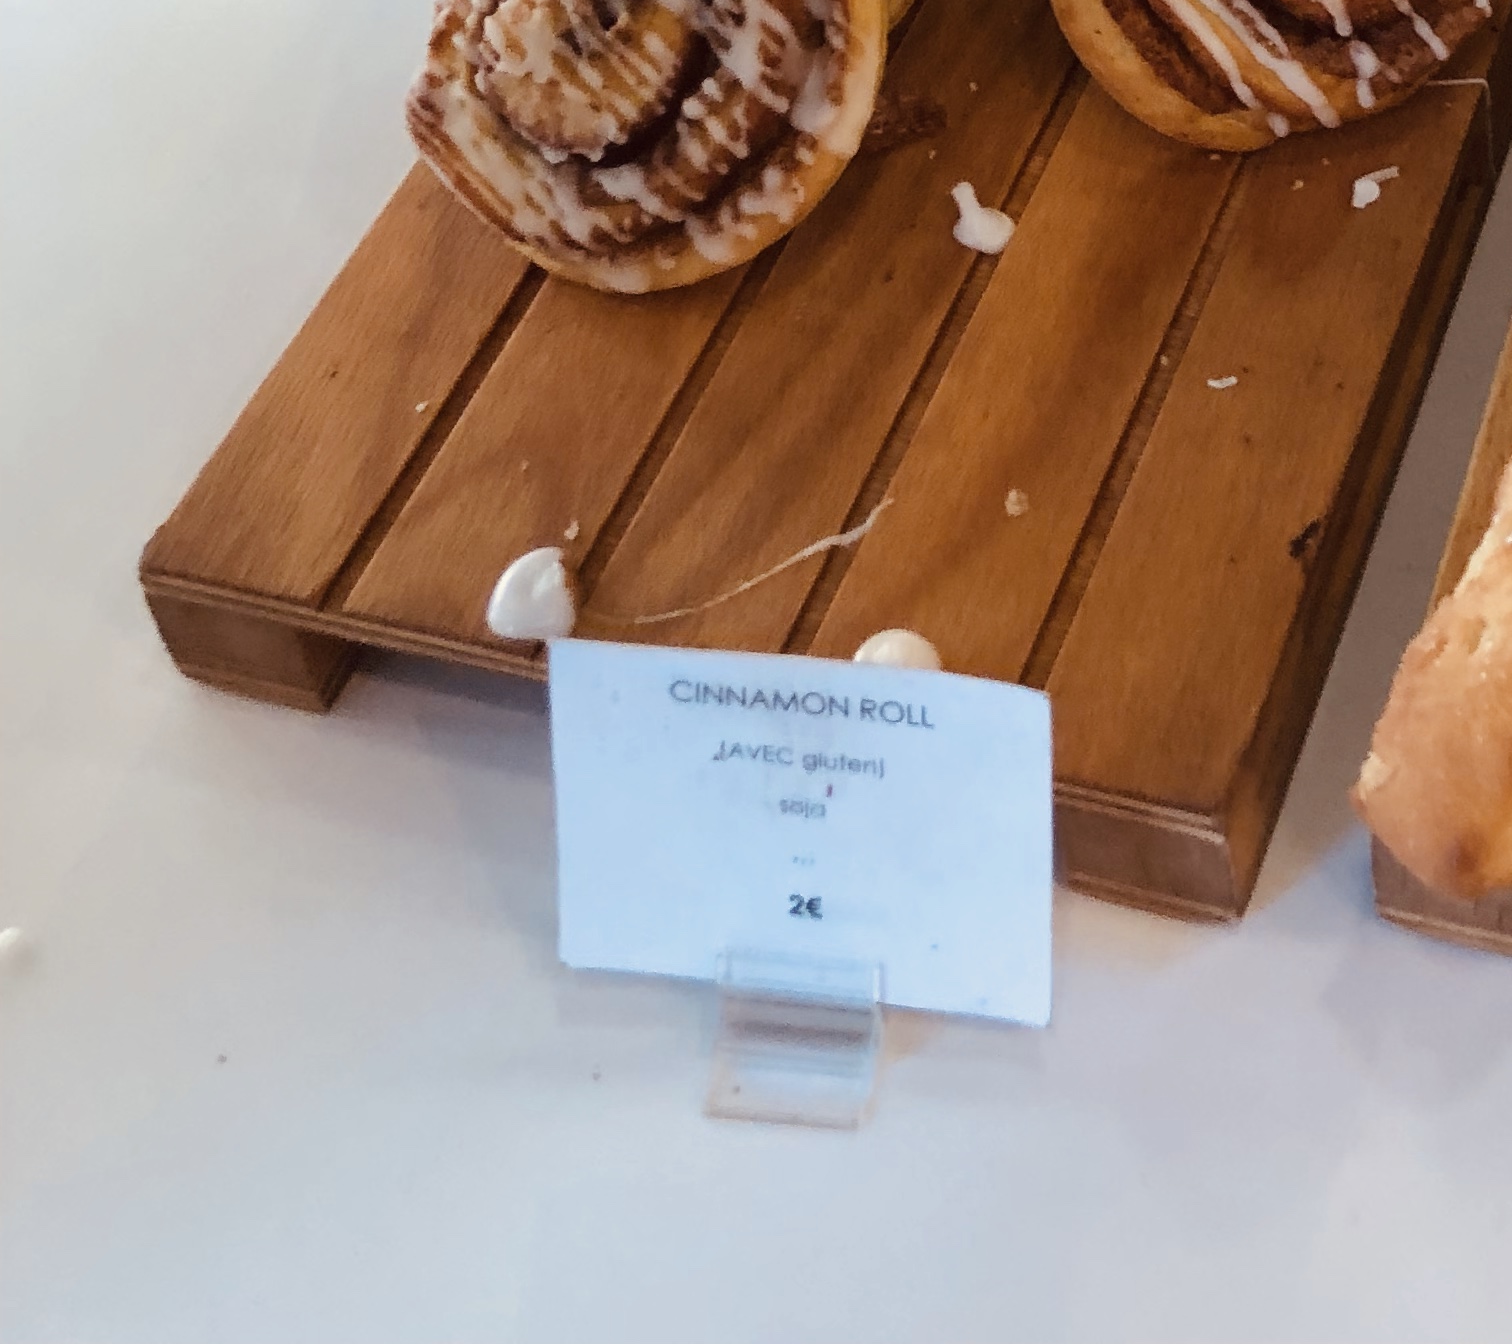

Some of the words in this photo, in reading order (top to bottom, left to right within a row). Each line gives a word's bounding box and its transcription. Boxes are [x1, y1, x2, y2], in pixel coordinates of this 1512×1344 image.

[669, 679, 849, 718] CINNAMON
[859, 697, 935, 729] ROLL
[788, 892, 824, 920] 2€
